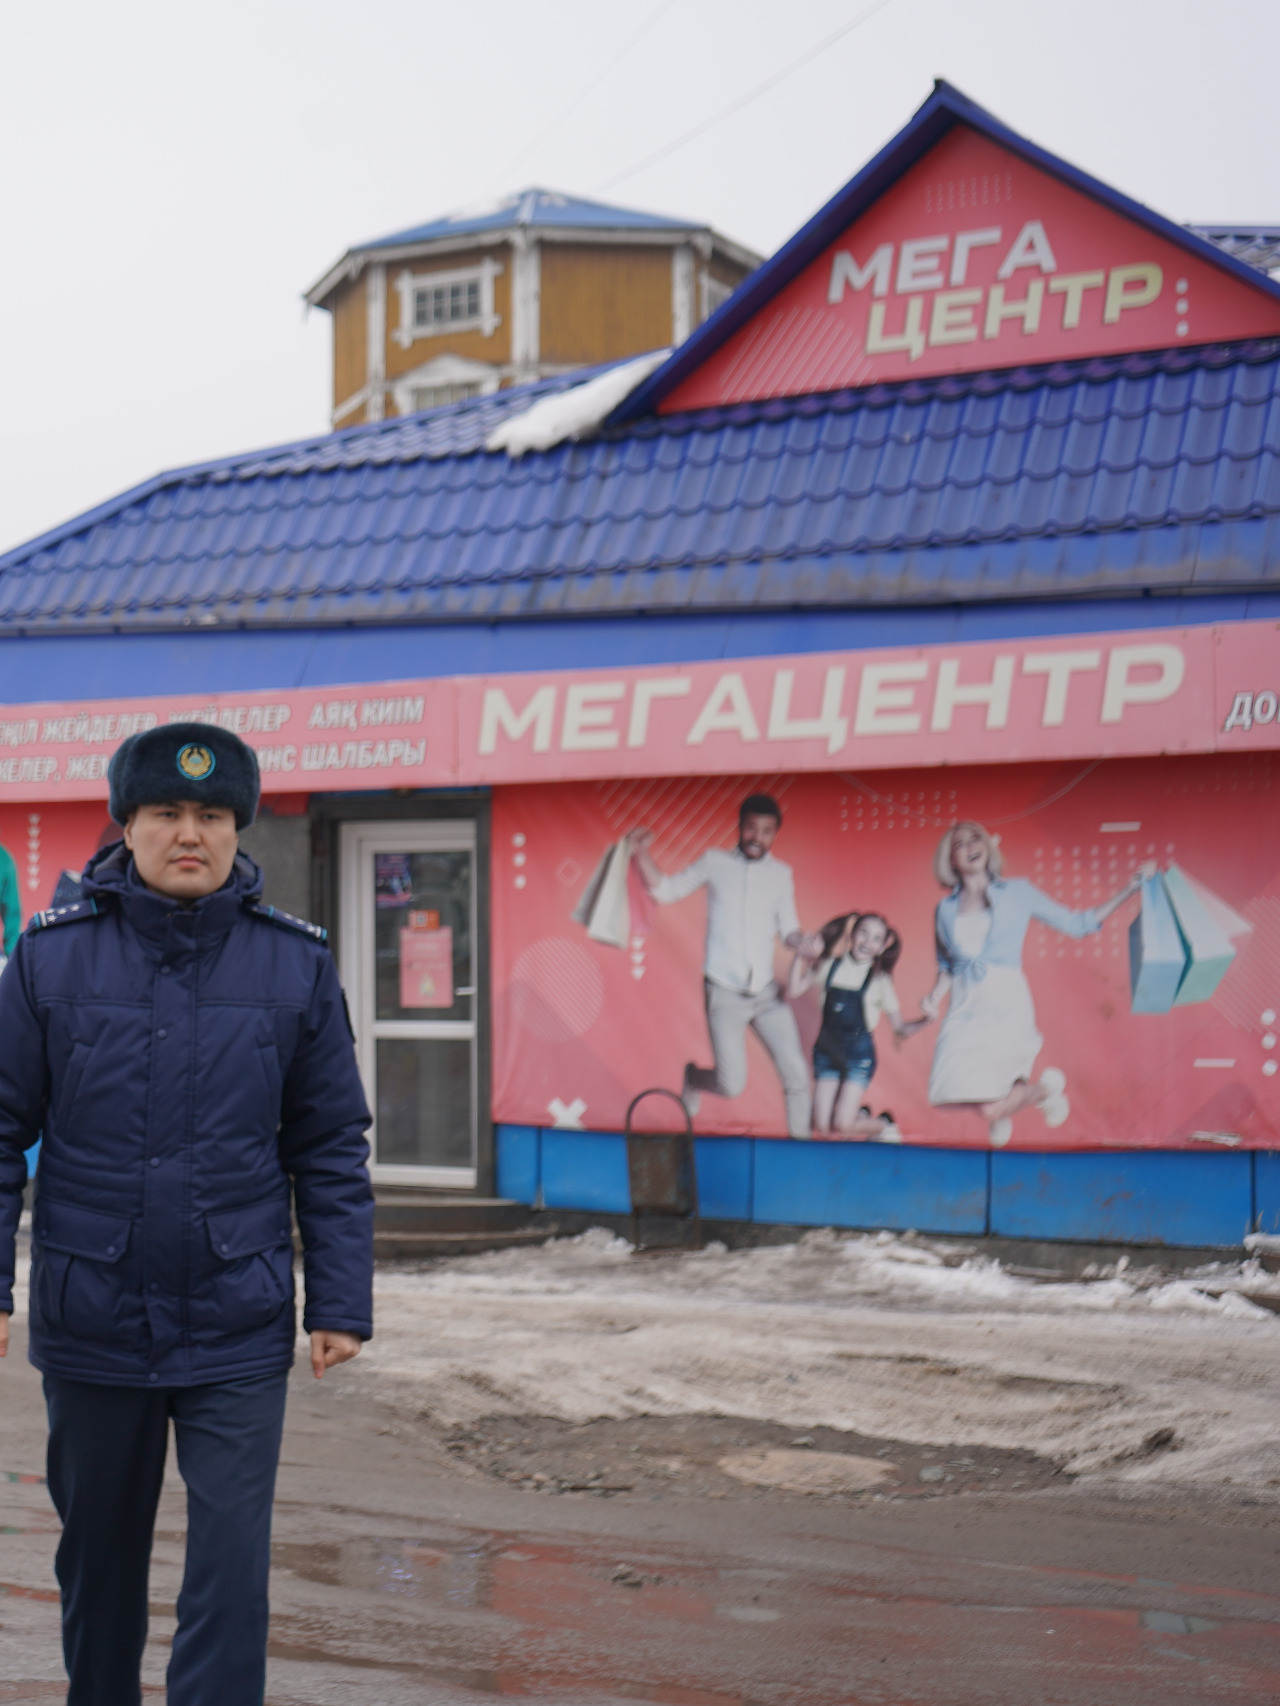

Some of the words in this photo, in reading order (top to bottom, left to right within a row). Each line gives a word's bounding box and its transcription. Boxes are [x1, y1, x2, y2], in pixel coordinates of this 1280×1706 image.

[827, 219, 1058, 305] МЕГА
[864, 261, 1164, 363] ЦЕНТР
[41, 710, 158, 745] ЖЕЙДЕЛЕР
[360, 695, 426, 726] КИІМ
[478, 643, 1186, 757] МЕГАЦЕНТР
[1222, 689, 1280, 733] ДО
[256, 744, 297, 773] ИНС
[300, 737, 428, 771] ШАЛБАРЫ
